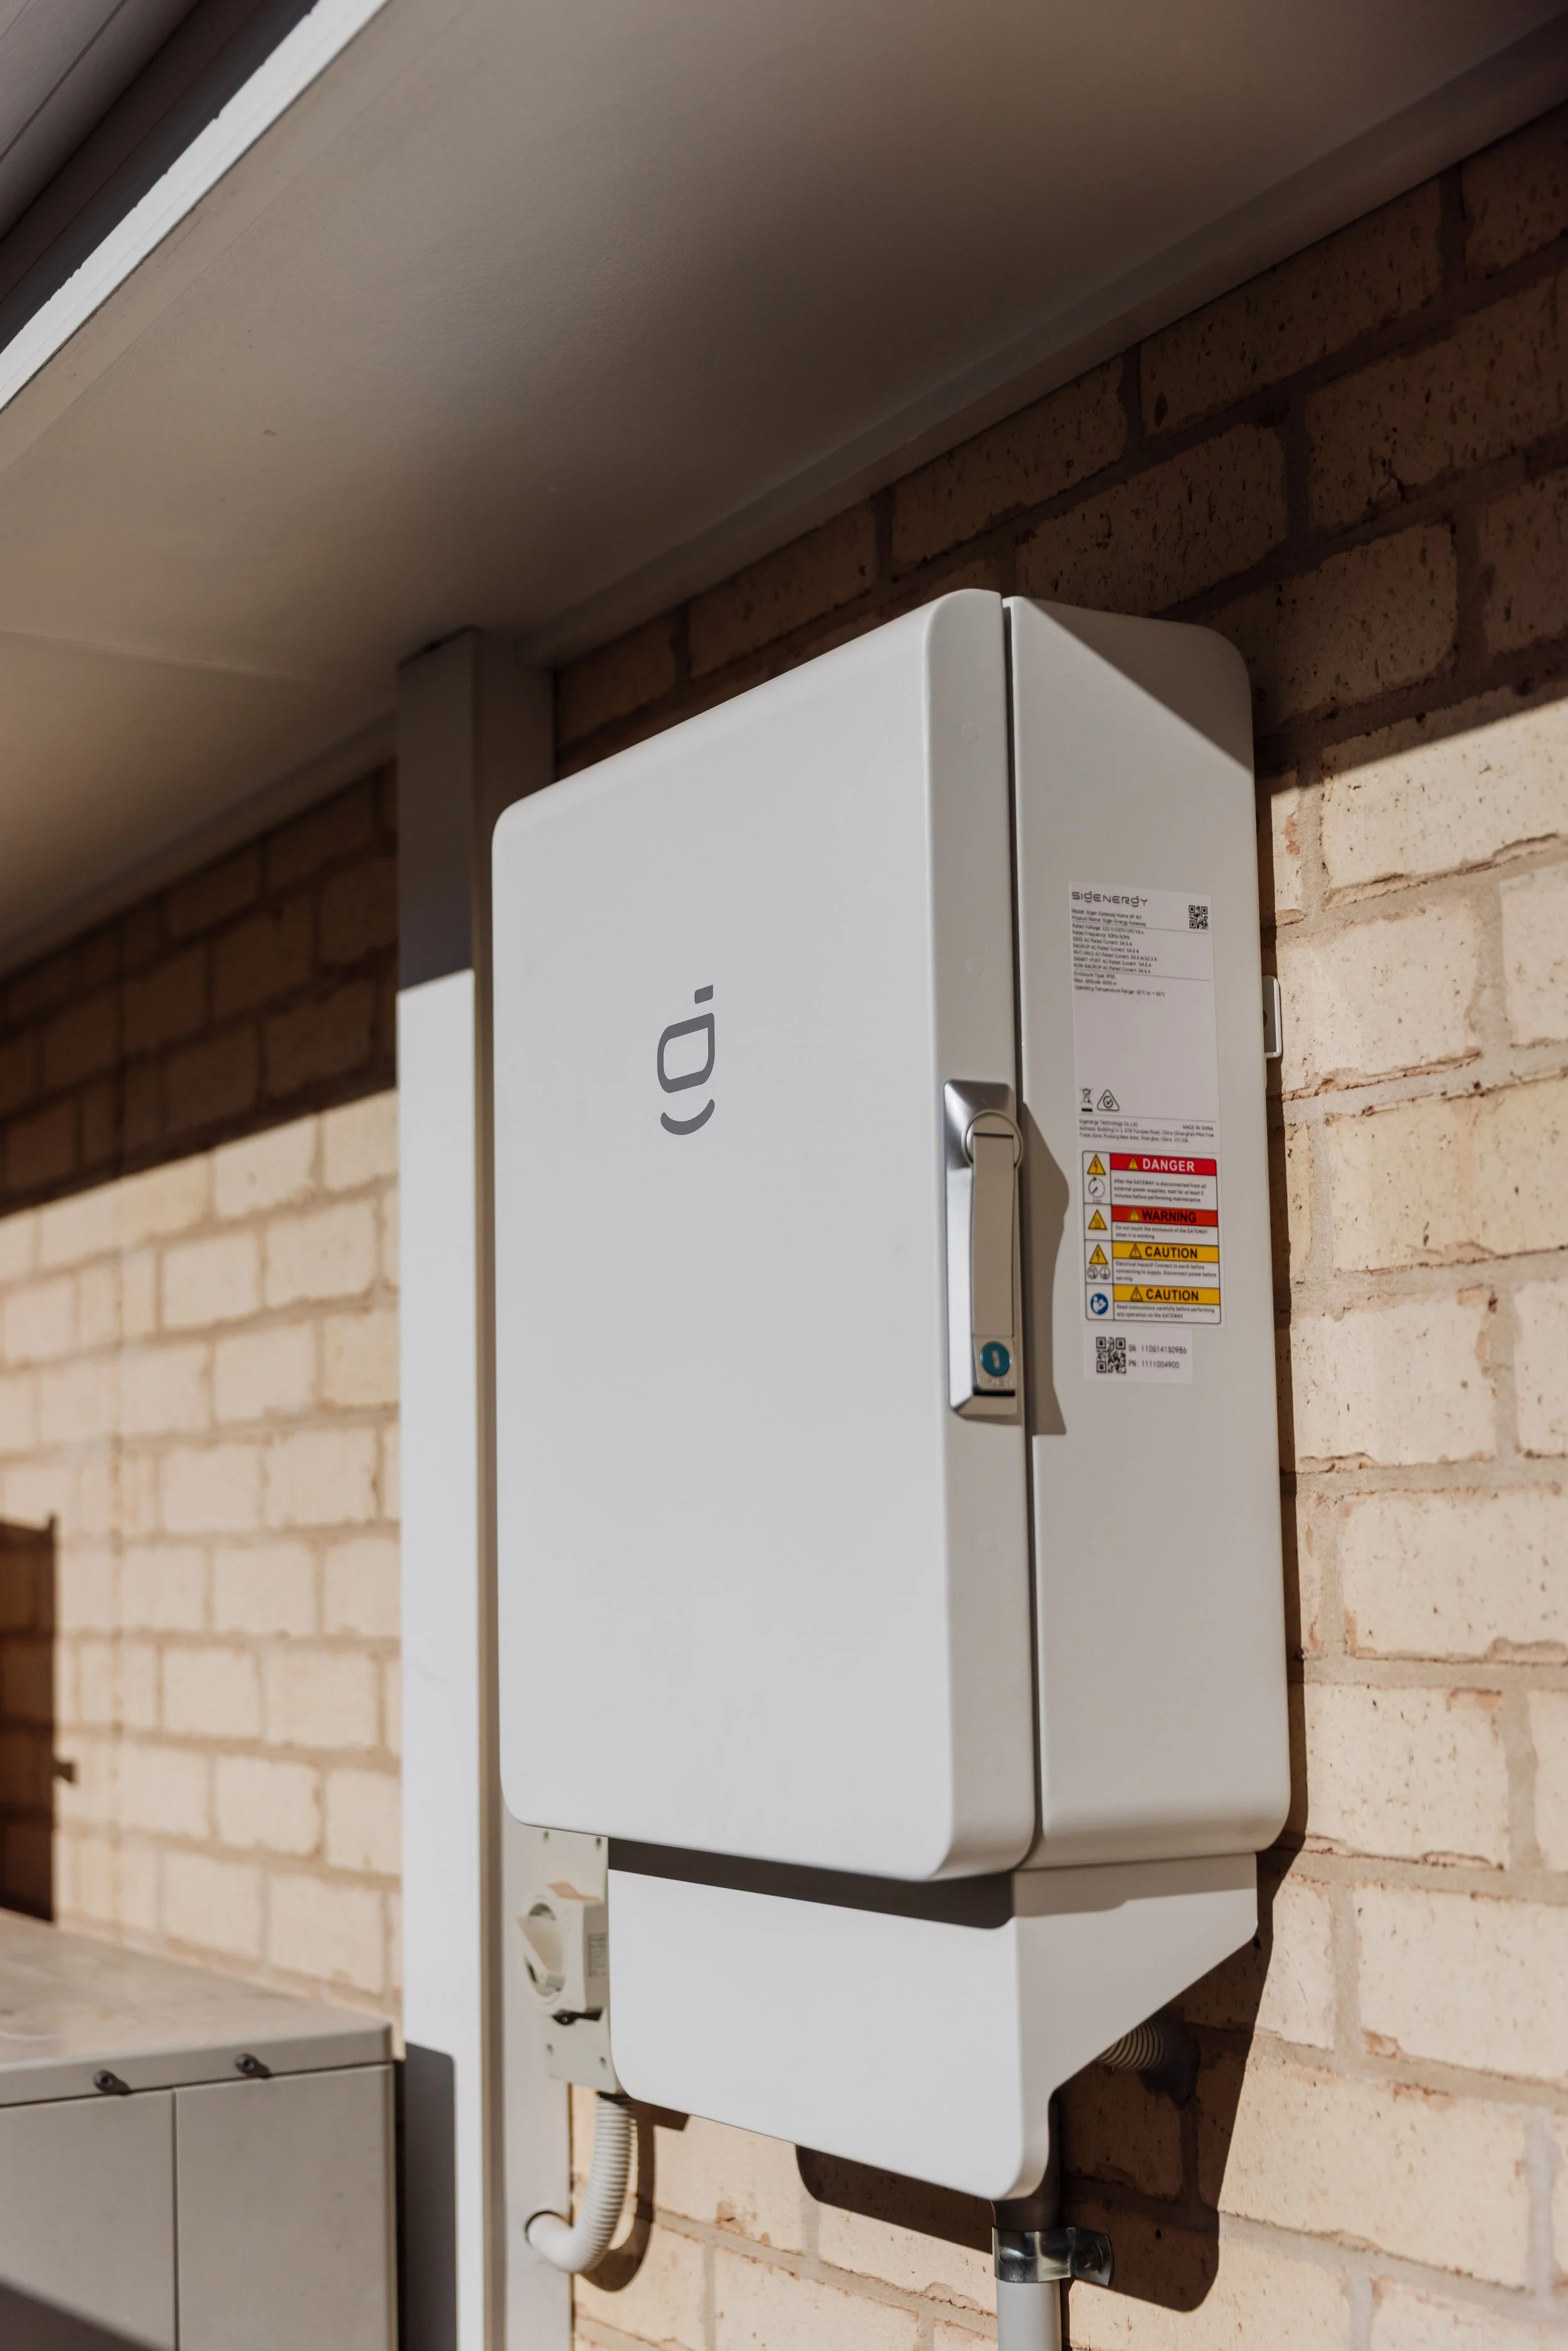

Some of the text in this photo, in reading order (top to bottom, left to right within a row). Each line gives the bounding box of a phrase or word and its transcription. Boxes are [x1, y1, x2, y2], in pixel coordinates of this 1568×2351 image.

[1143, 1158, 1195, 1172] DANGER
[1142, 1209, 1197, 1223] WARNING
[1145, 1246, 1197, 1259] CAUTION
[1146, 1288, 1199, 1301] CAUTION
